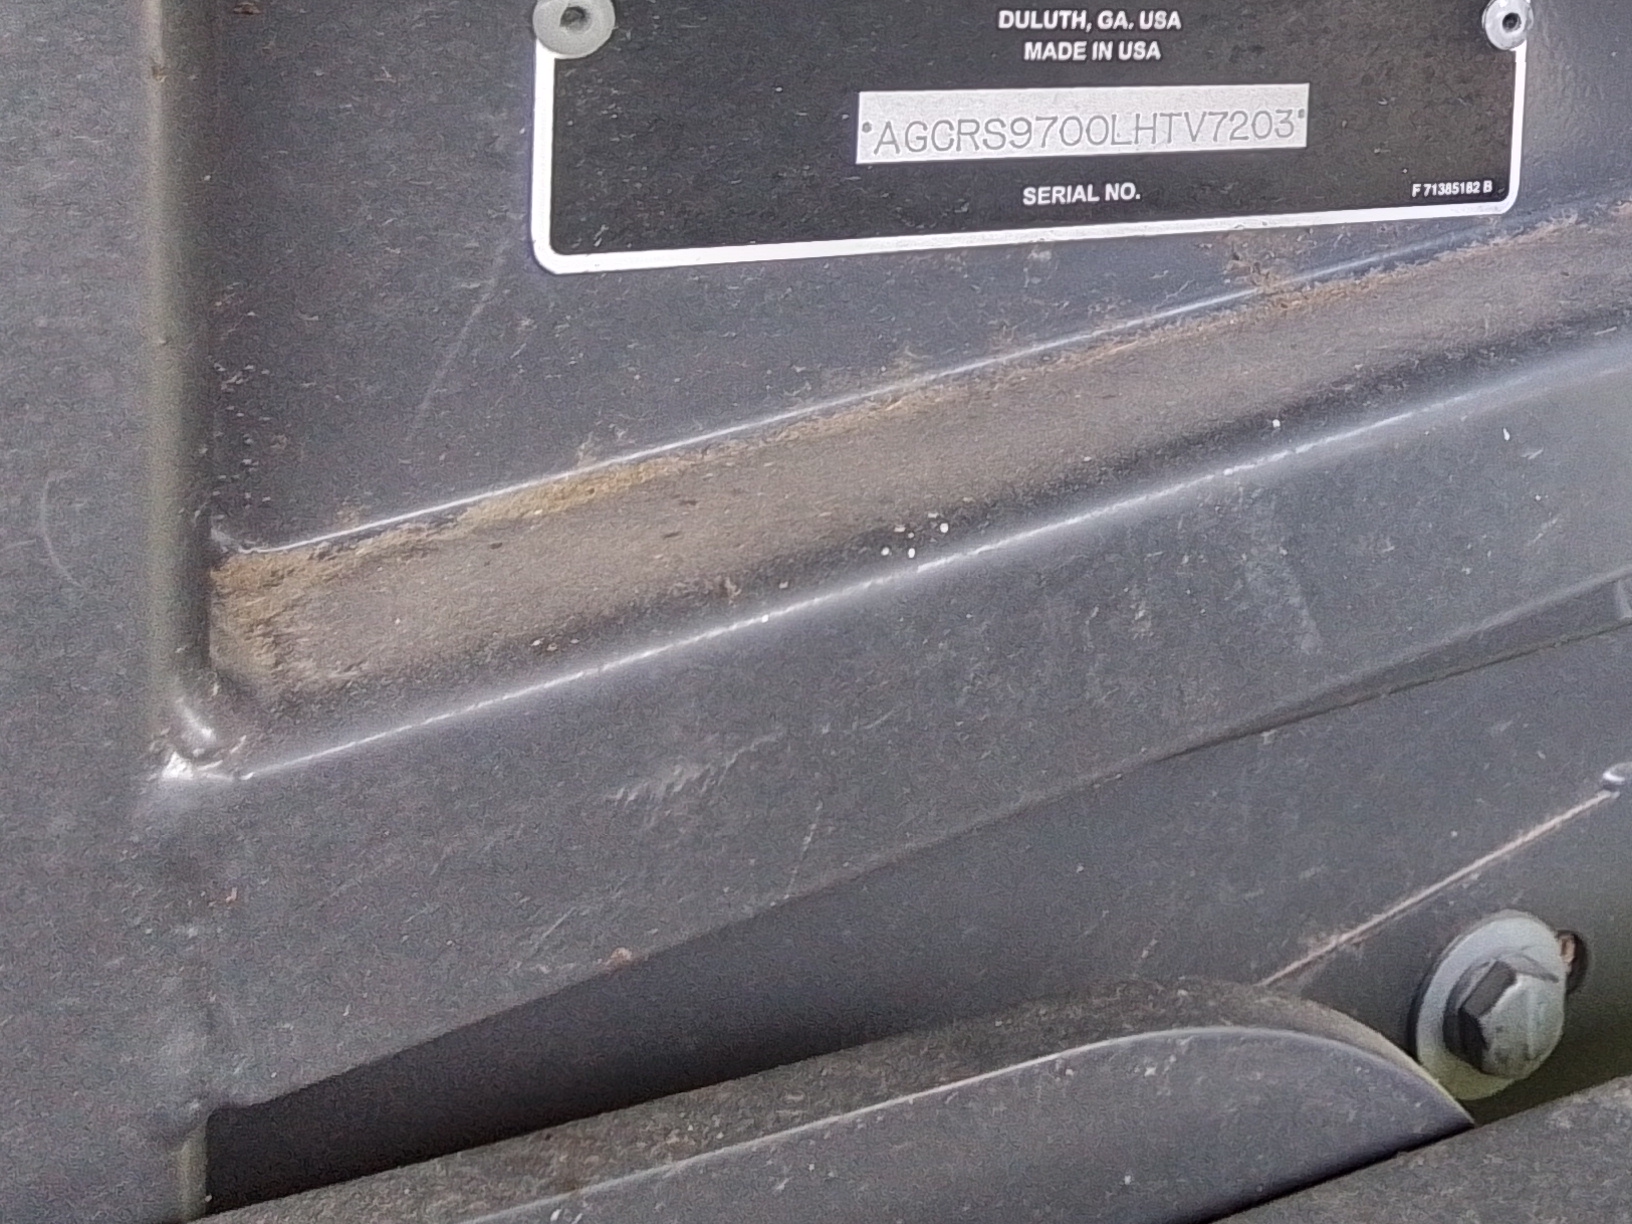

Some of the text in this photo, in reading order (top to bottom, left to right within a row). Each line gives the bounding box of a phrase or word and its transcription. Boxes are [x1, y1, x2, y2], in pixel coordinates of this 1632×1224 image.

[998, 9, 1092, 33] DULUTH,
[1139, 10, 1182, 30] USA
[1023, 40, 1162, 61] MADE IN USA
[1022, 182, 1141, 207] SERIAL NO.
[1411, 183, 1422, 198] F
[1482, 179, 1493, 194] B
